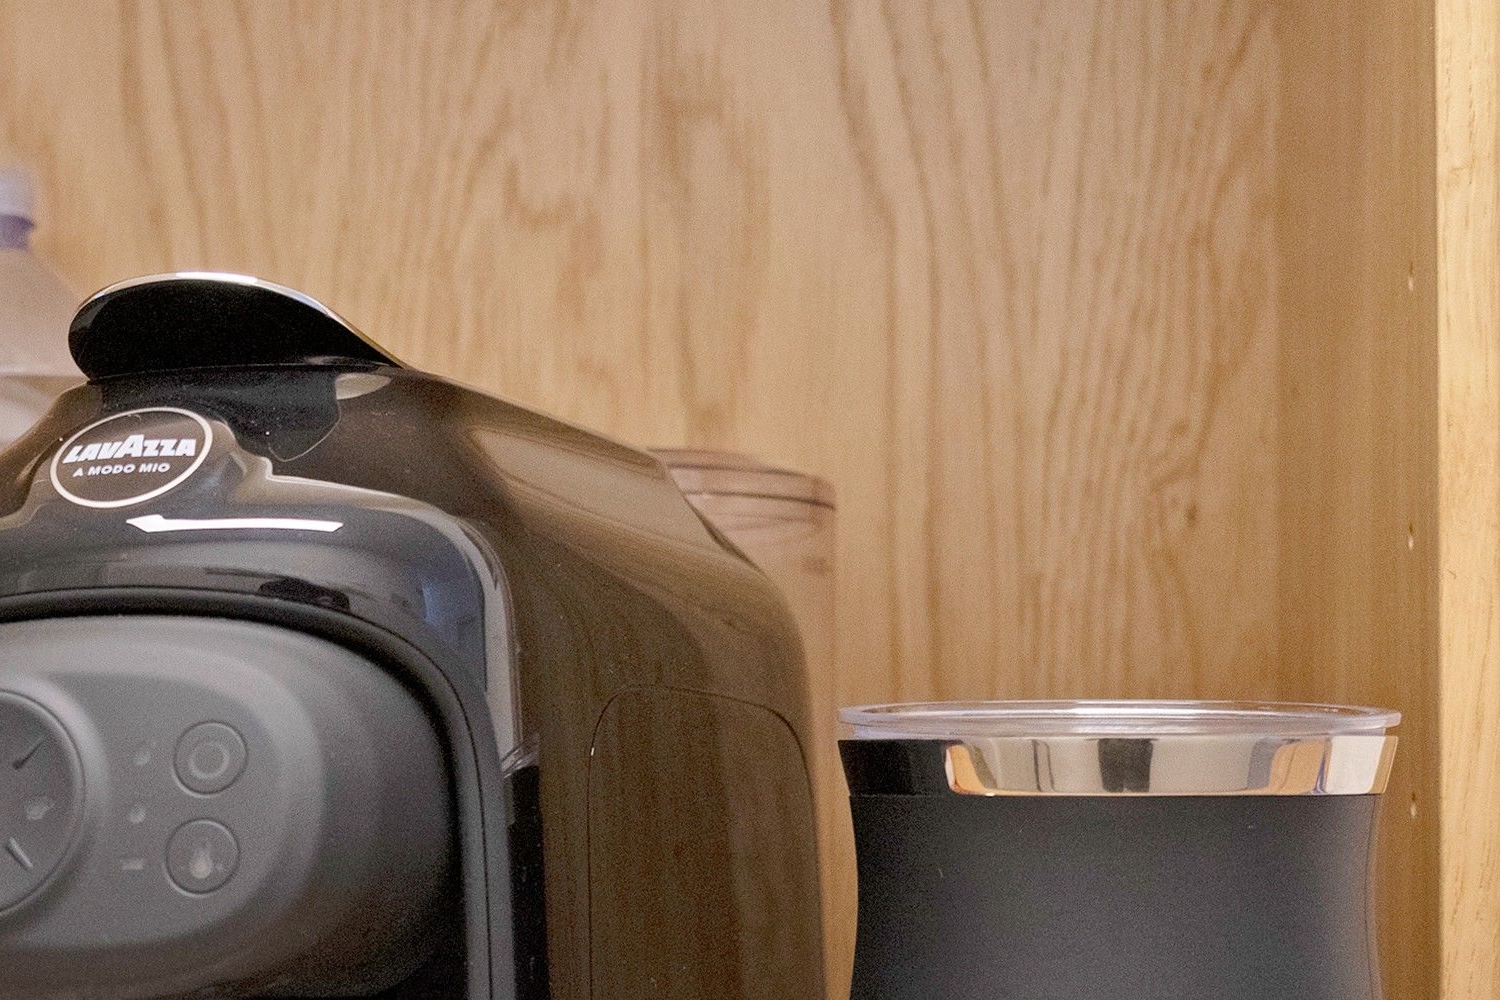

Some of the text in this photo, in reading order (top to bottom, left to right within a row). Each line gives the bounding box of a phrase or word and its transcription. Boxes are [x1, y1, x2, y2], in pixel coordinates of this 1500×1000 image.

[63, 434, 196, 463] LAVAZZA
[73, 462, 171, 478] A MODO MIO
